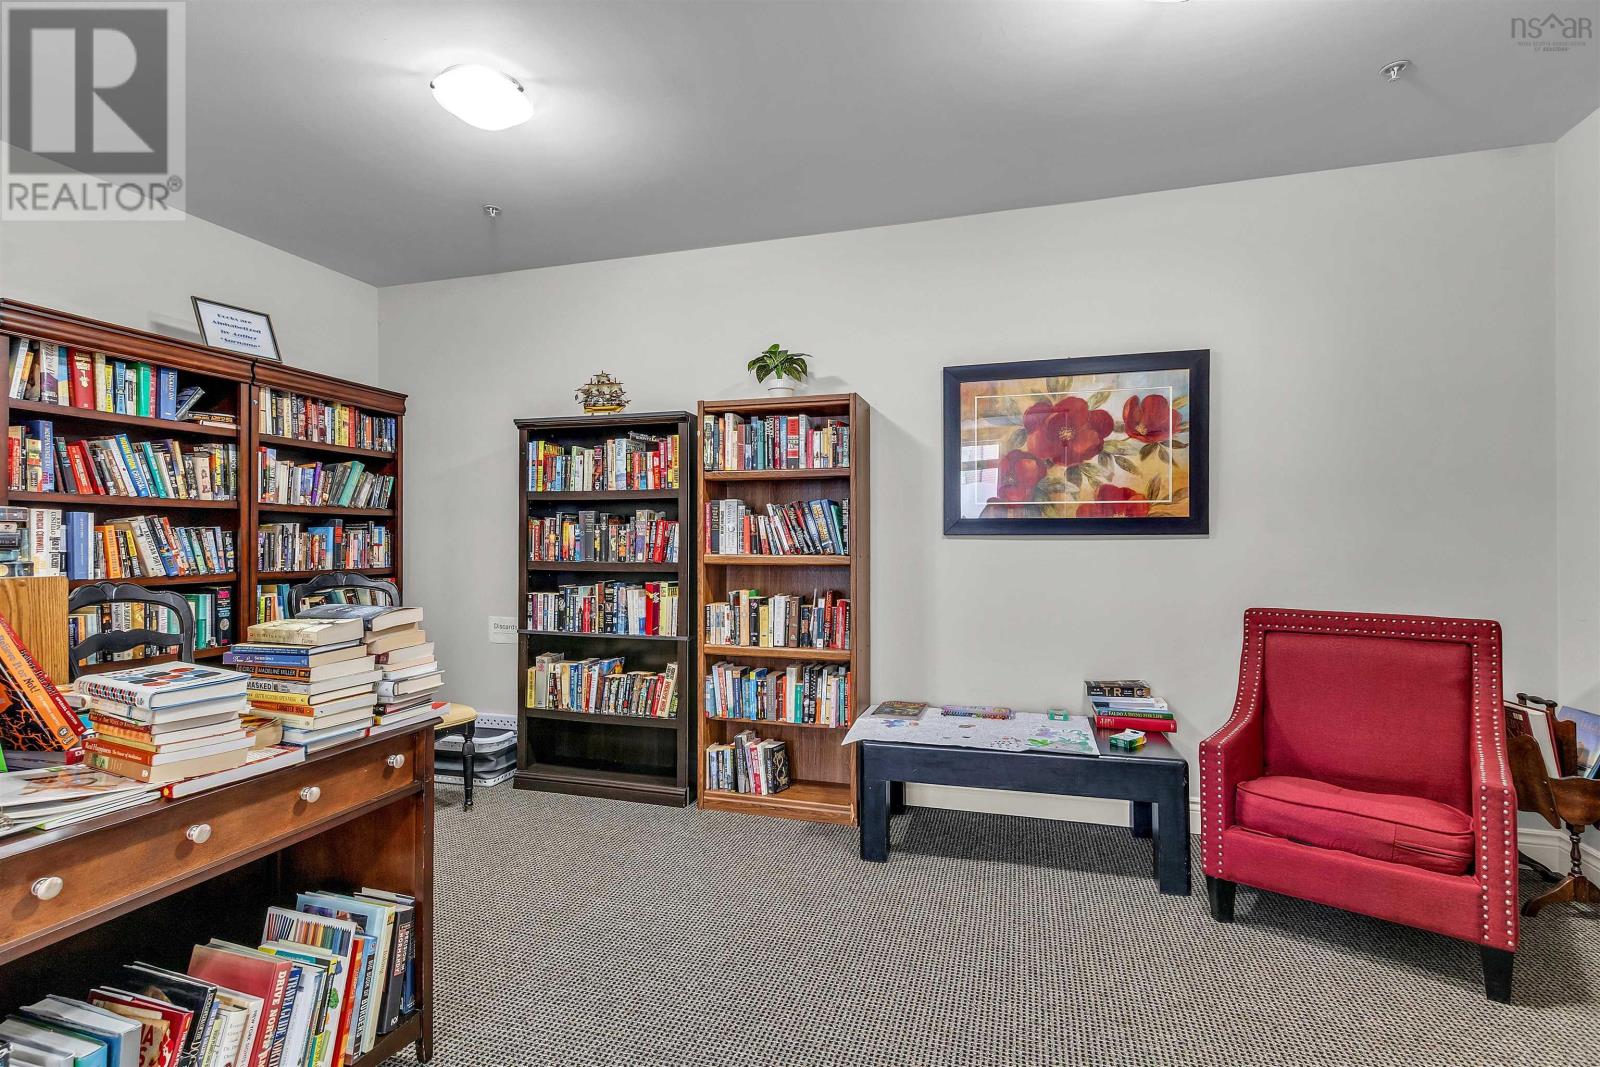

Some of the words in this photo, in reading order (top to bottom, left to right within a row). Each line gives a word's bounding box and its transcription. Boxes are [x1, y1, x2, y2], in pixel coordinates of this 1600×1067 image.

[394, 932, 404, 974] NORMANDY
[272, 970, 287, 1006] DRIVE
[356, 999, 368, 1038] BURGERS
